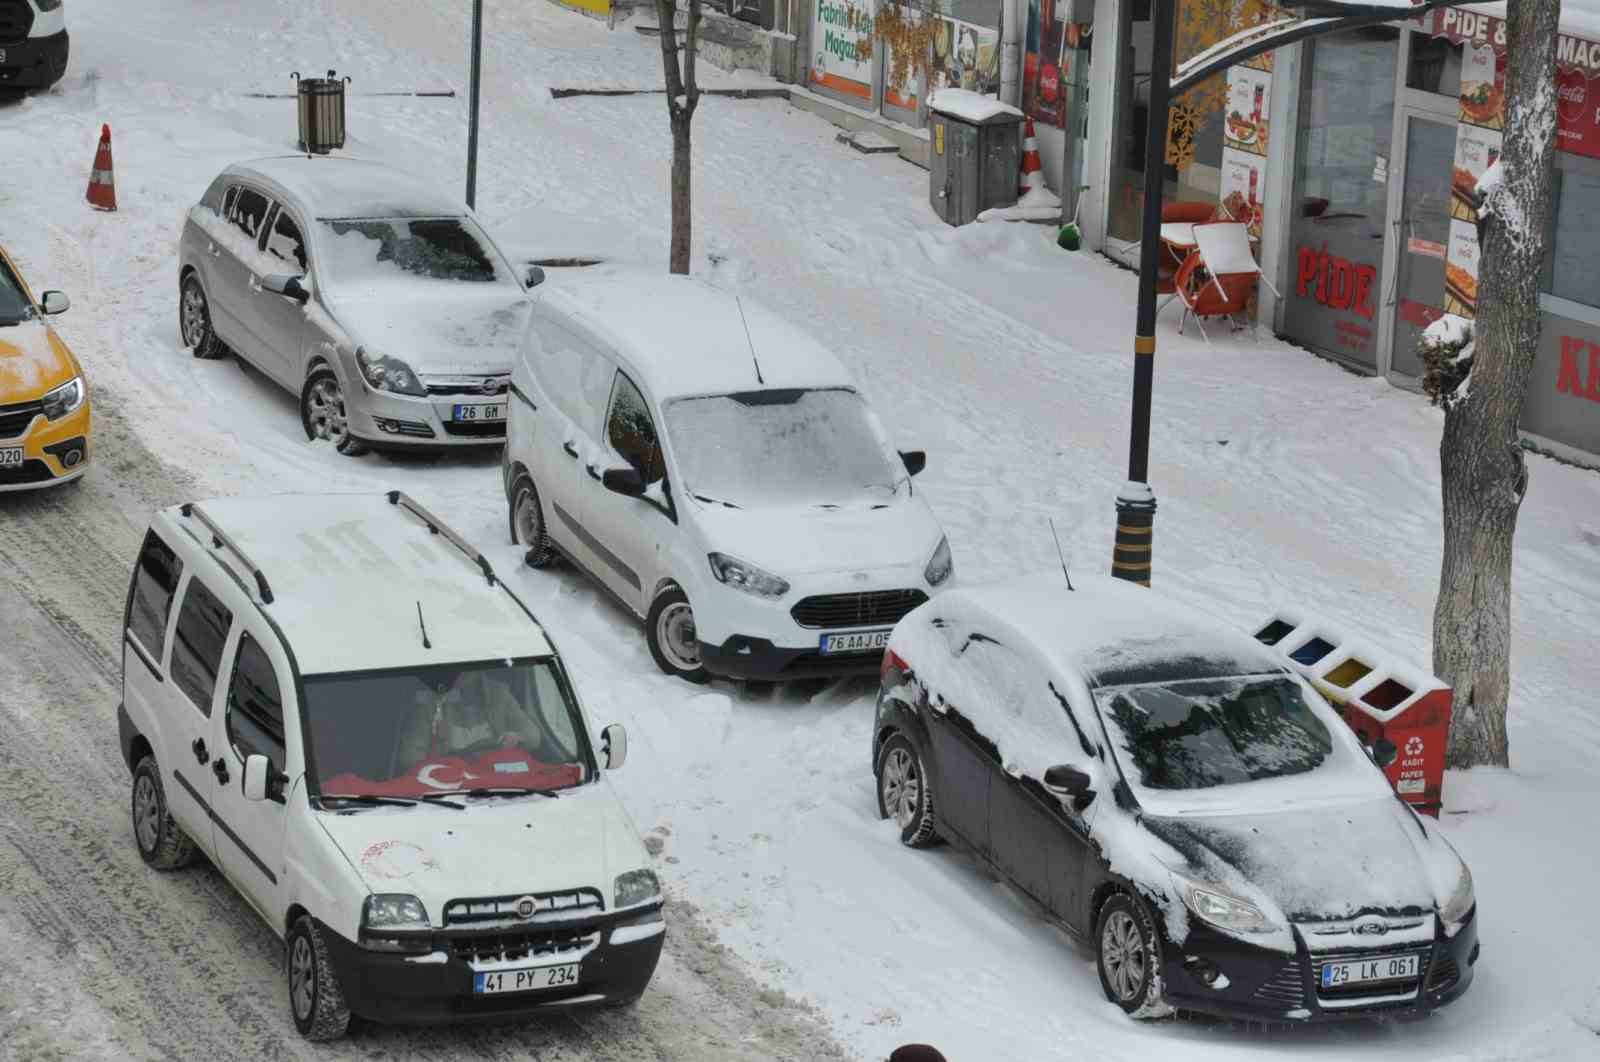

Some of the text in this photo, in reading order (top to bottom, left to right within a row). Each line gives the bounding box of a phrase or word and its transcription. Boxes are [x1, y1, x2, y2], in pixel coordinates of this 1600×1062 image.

[463, 406, 476, 418] 26
[829, 636, 845, 650] 76
[848, 634, 873, 648] AAJ
[486, 966, 575, 991] 41 PY 234
[1333, 957, 1415, 983] 25 LK 061
